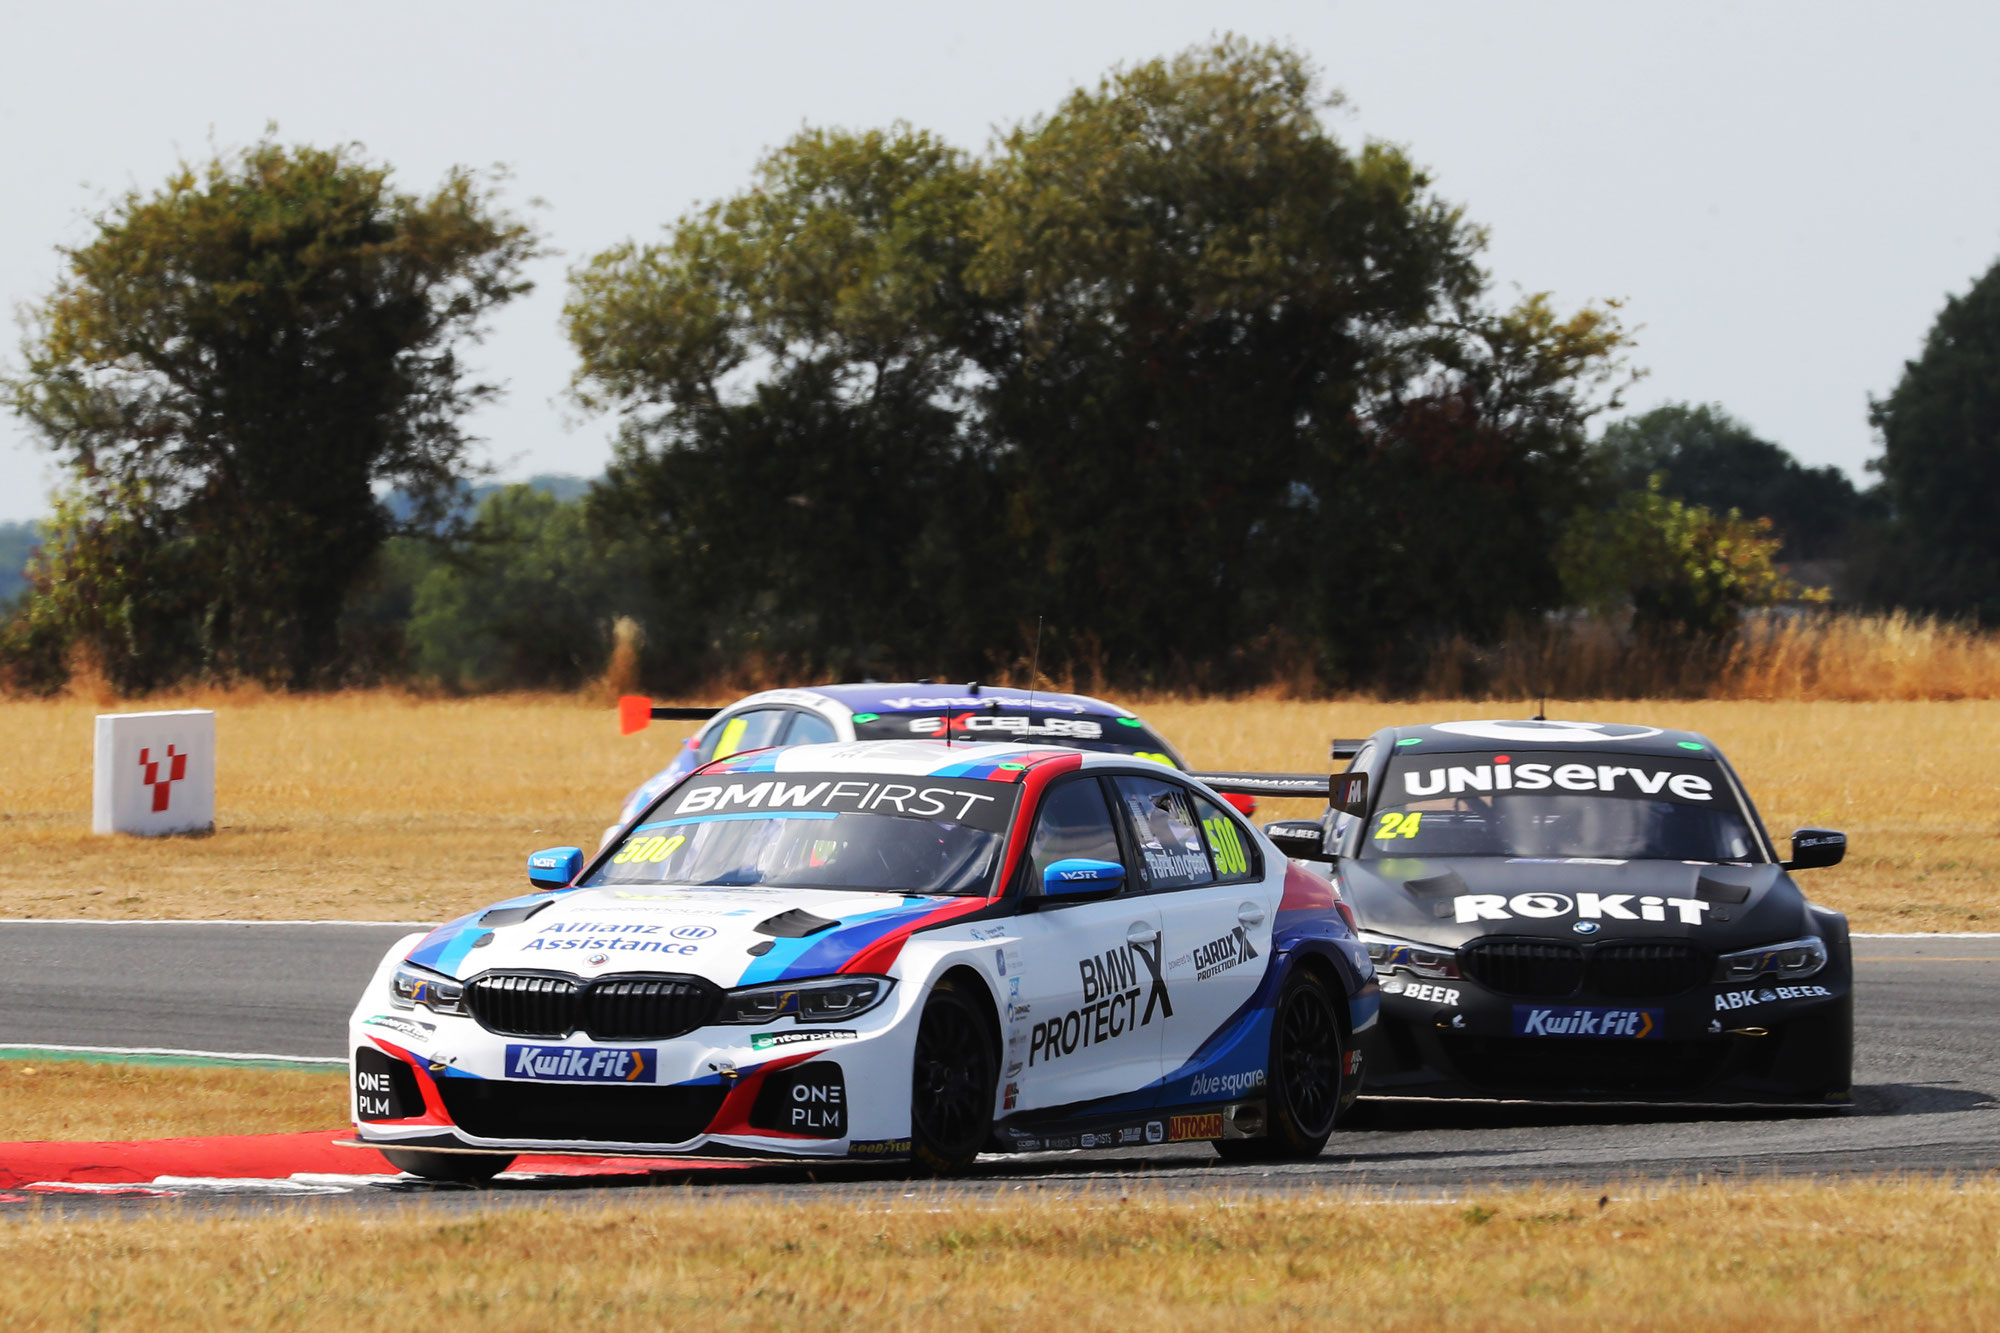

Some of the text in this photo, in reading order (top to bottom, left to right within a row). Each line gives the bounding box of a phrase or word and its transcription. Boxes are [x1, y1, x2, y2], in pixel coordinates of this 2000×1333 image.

[1374, 812, 1423, 839] 24
[613, 834, 686, 864] 500
[1202, 816, 1247, 874] 500
[1060, 870, 1098, 880] WSR
[538, 922, 665, 935] Allianz
[520, 936, 699, 956] Assistance
[1079, 944, 1136, 1003] BMW
[1197, 958, 1237, 981] PROTECTION
[1403, 983, 1460, 1006] BEER
[1715, 985, 1831, 1012] ABK BEER
[1029, 987, 1141, 1067] PROTECT
[757, 1030, 857, 1047] enterprise
[358, 1071, 390, 1092] ONE
[792, 1084, 842, 1103] ONE
[359, 1095, 390, 1116] PLM
[792, 1108, 840, 1127] PLM
[1170, 1114, 1222, 1140] AUTOCAR
[850, 1139, 912, 1155] GOODYEAR
